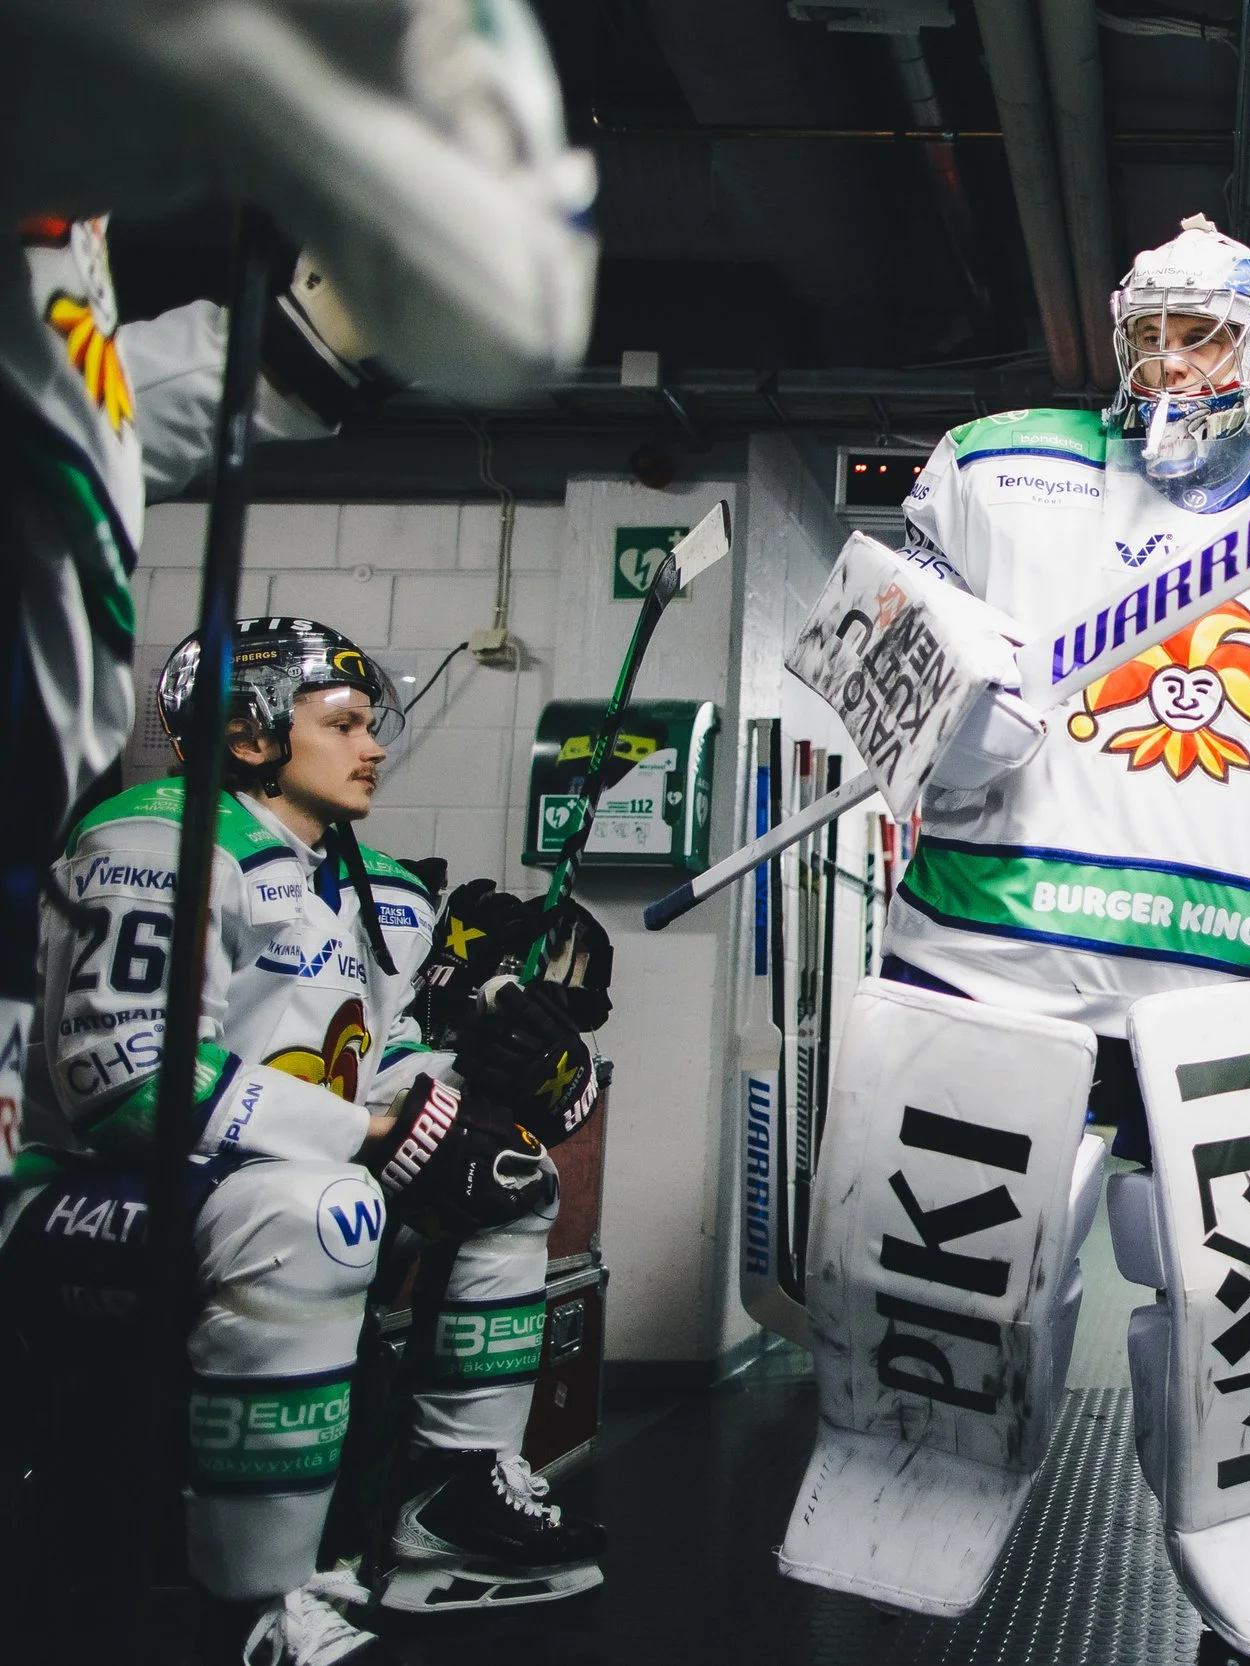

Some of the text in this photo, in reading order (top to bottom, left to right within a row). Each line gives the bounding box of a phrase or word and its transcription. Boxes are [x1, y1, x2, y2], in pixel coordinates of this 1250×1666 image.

[1020, 434, 1083, 451] bondata
[997, 475, 1100, 497] Terveystalo
[630, 798, 653, 813] 112
[380, 906, 405, 917] TAKSI
[1032, 881, 1174, 927] BURGER
[67, 1031, 163, 1097] CHS
[466, 1161, 477, 1196] ALPHA
[746, 1077, 770, 1277] WARRIOR
[44, 1194, 149, 1244] HALT
[876, 1105, 1033, 1416] PIKI
[803, 1453, 834, 1526] FLYLITE
